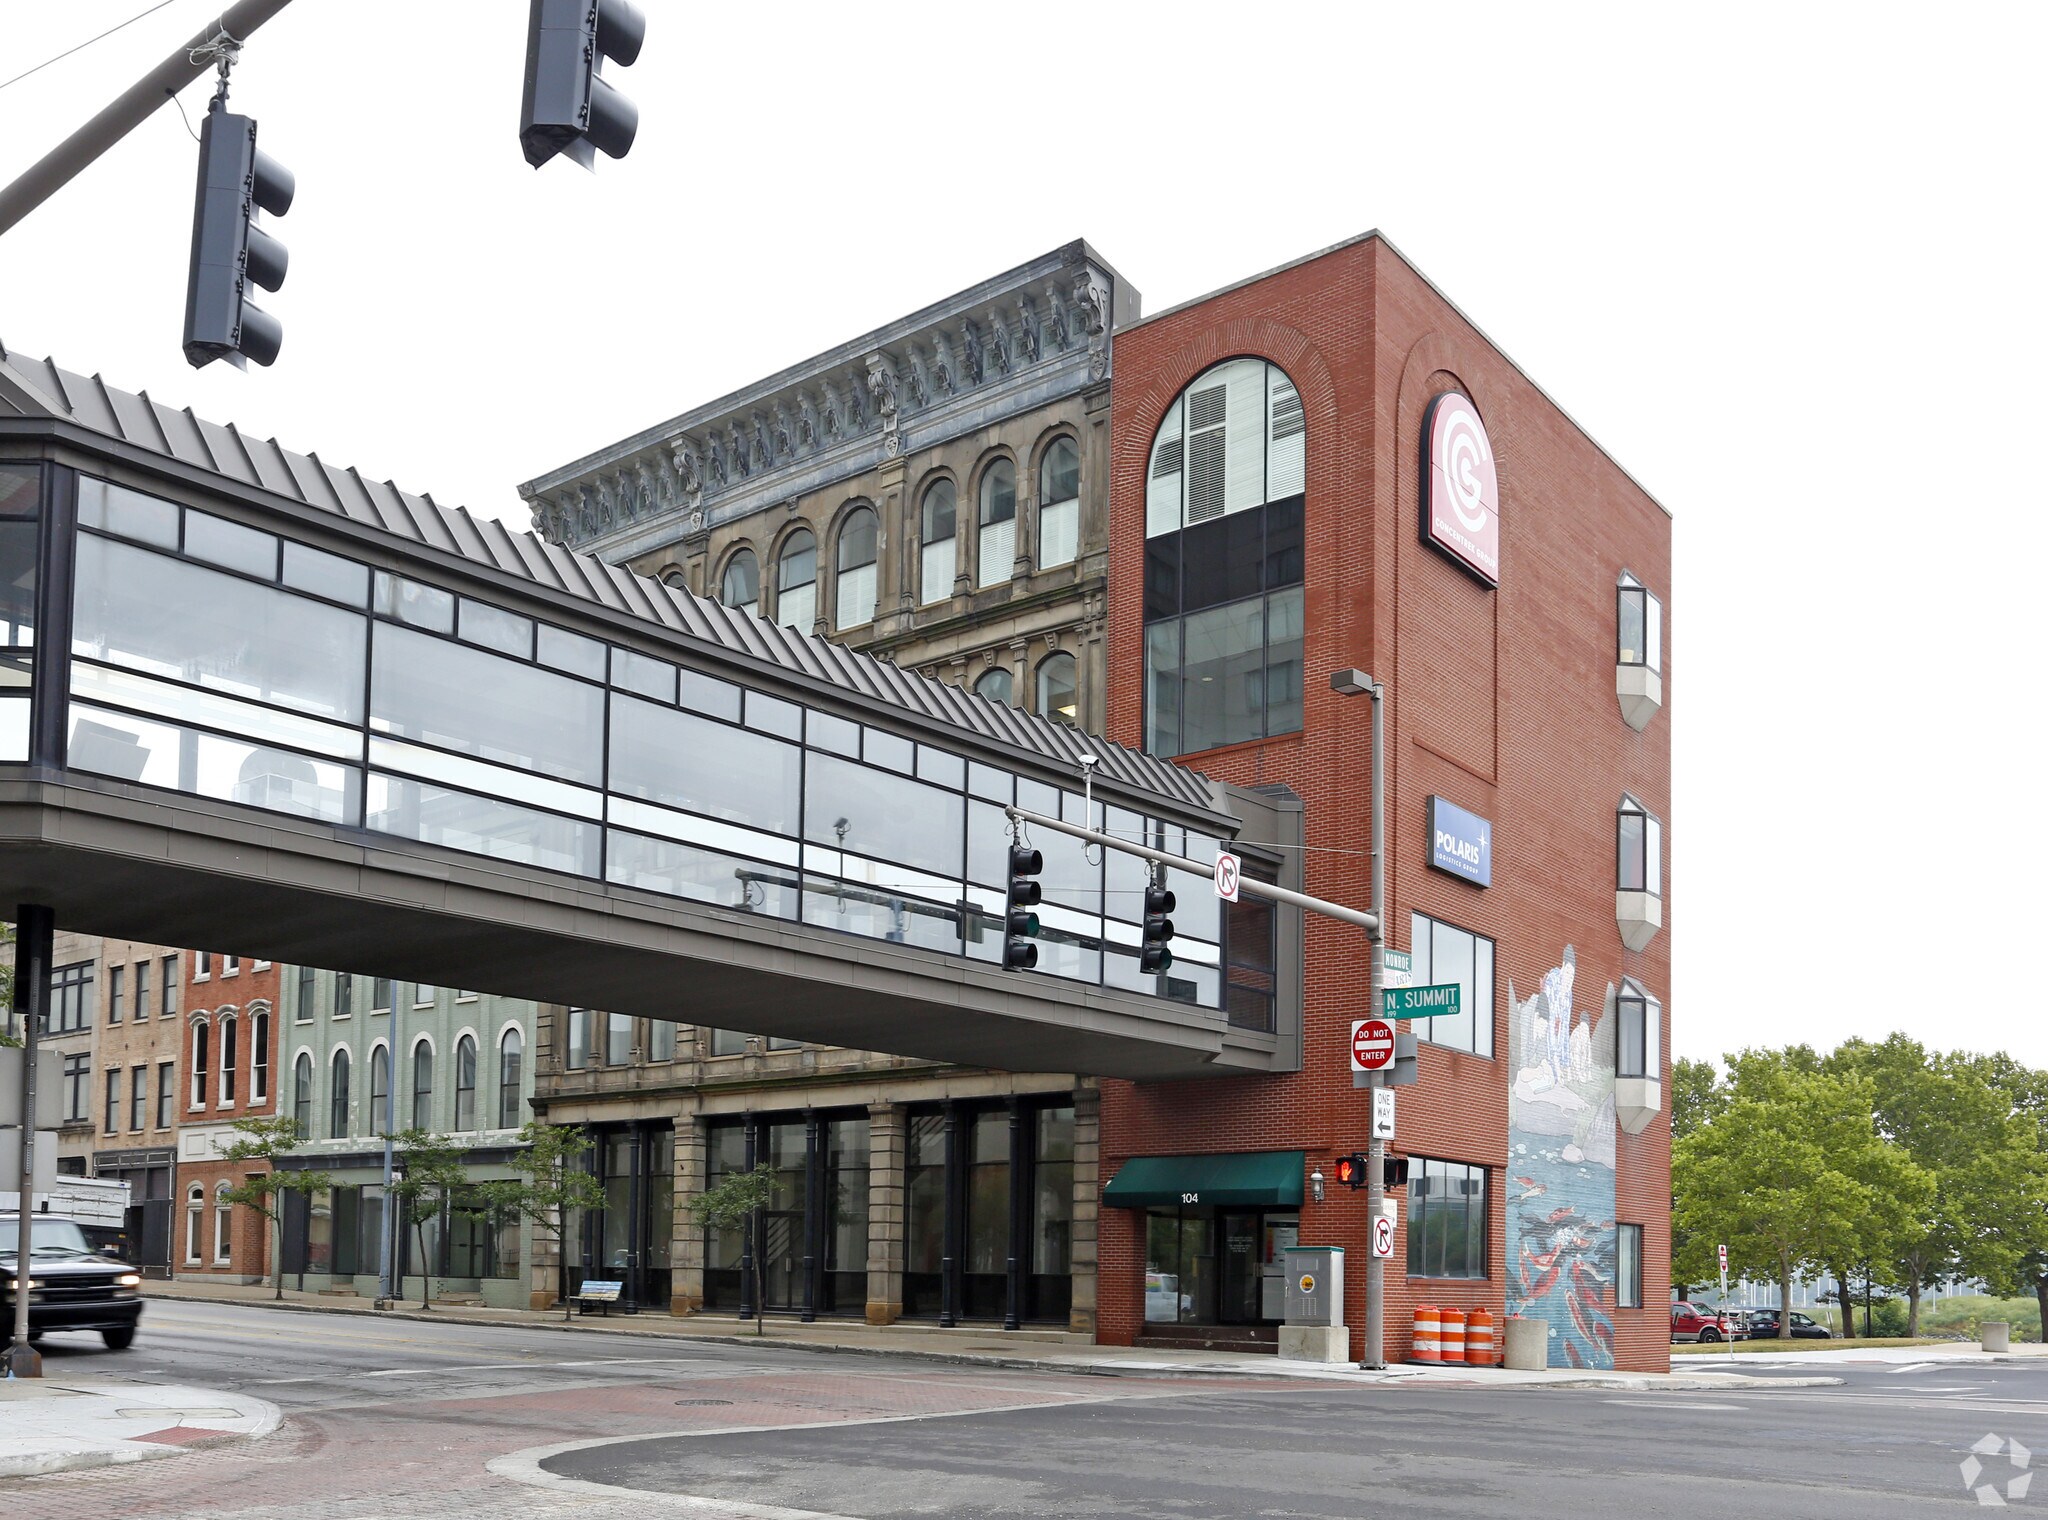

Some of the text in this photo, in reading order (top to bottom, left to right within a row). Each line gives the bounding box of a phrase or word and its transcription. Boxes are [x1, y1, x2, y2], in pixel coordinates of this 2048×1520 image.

[1476, 548, 1496, 569] GROUP
[1436, 830, 1479, 864] POLARIS
[1436, 852, 1479, 874] LOGISTICS GROUP
[1385, 952, 1410, 970] MONROE
[1387, 988, 1457, 1010] N. SUMMIT
[1387, 1005, 1458, 1018] 199 100
[1358, 1028, 1389, 1039] DO NOT
[1360, 1051, 1386, 1061] ENTER
[1377, 1093, 1391, 1106] ONE
[1377, 1106, 1391, 1120] WAY
[1181, 1193, 1199, 1204] 104
